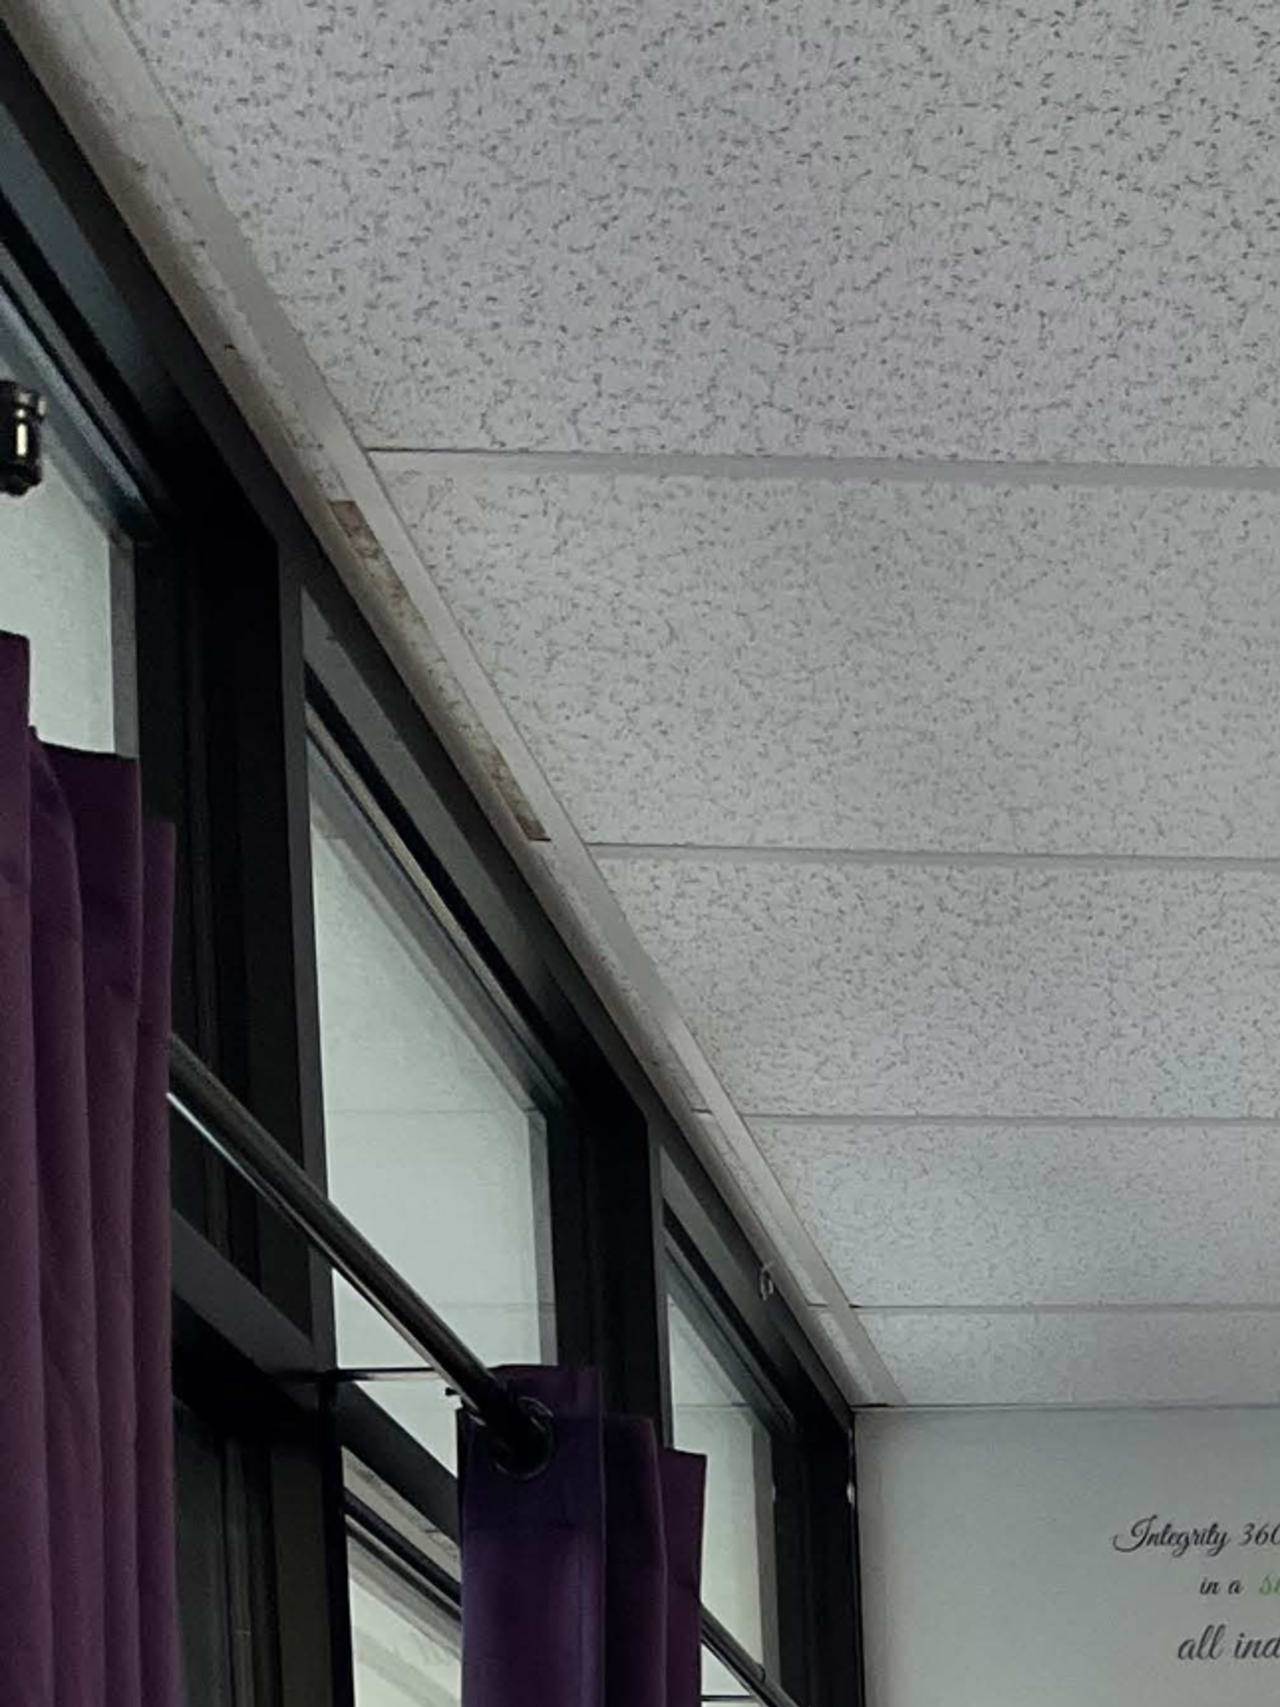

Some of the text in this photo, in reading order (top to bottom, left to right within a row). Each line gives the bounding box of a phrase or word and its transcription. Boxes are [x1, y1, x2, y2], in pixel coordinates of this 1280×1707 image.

[1112, 1514, 1230, 1557] Integrity
[1199, 1576, 1221, 1595] in
[1227, 1578, 1245, 1595] a
[1177, 1623, 1227, 1661] all
